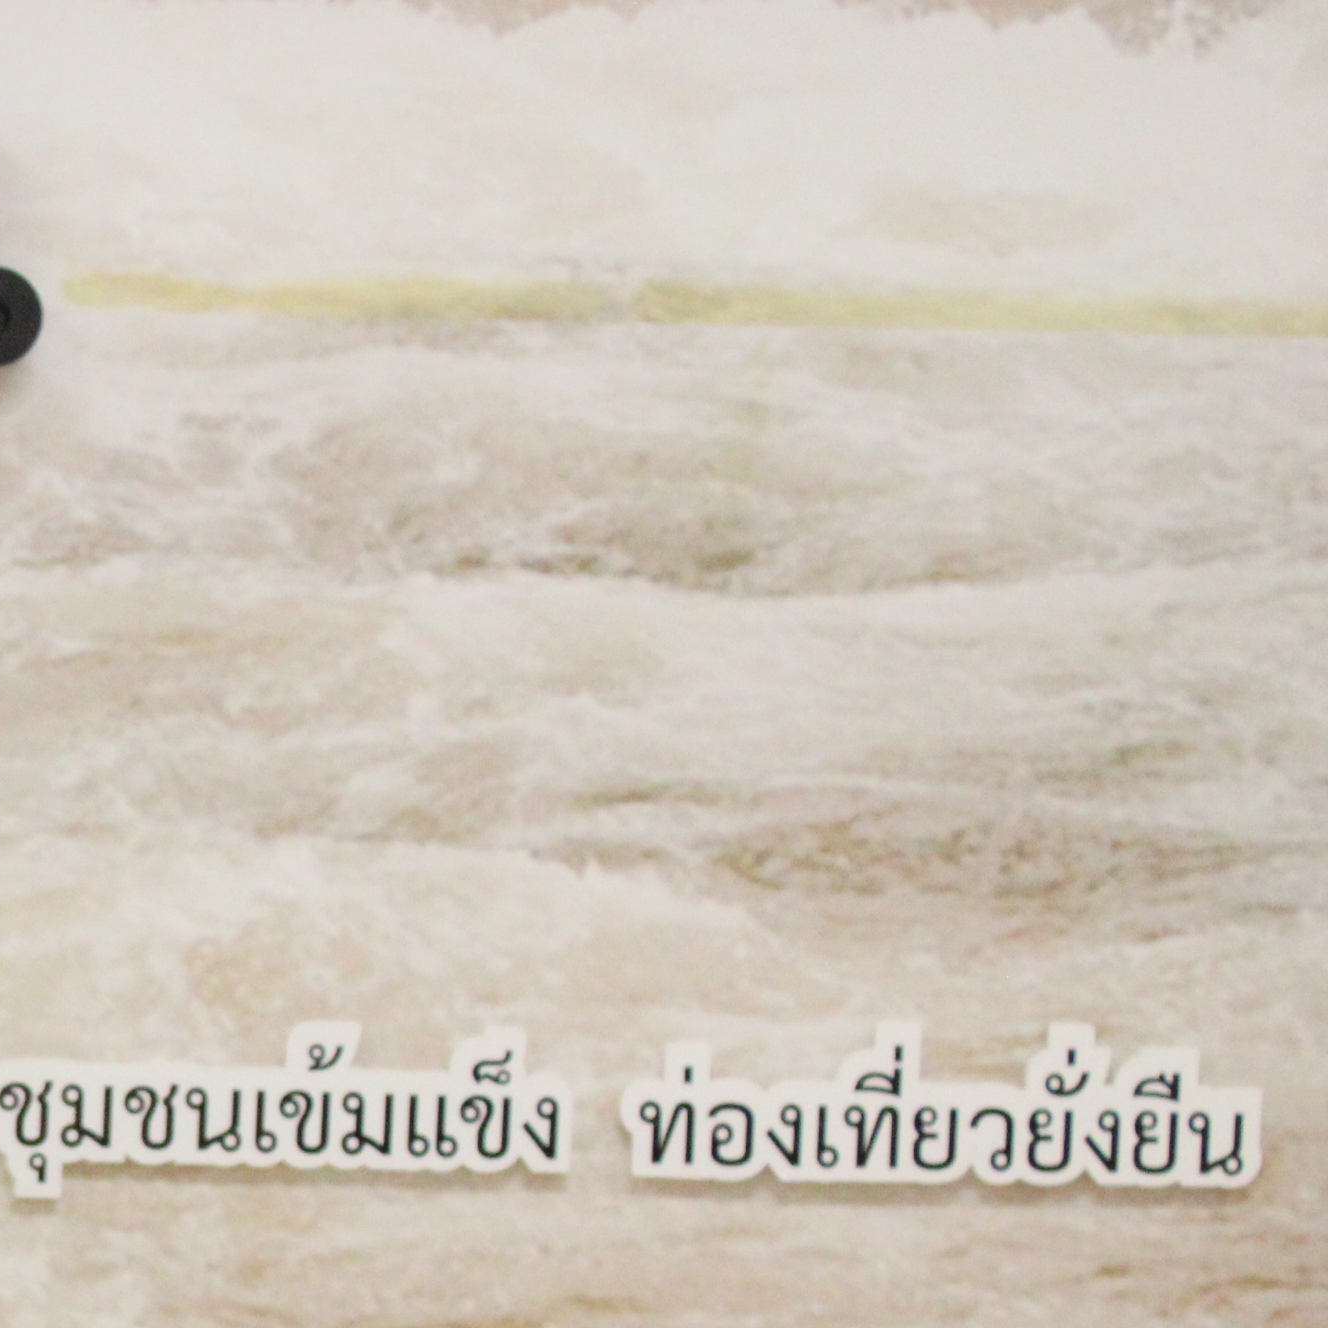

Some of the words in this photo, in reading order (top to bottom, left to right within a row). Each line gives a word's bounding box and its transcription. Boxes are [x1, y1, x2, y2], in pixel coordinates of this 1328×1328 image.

[637, 1045, 1245, 1178] ท่องเที่ยวยั่งยืน
